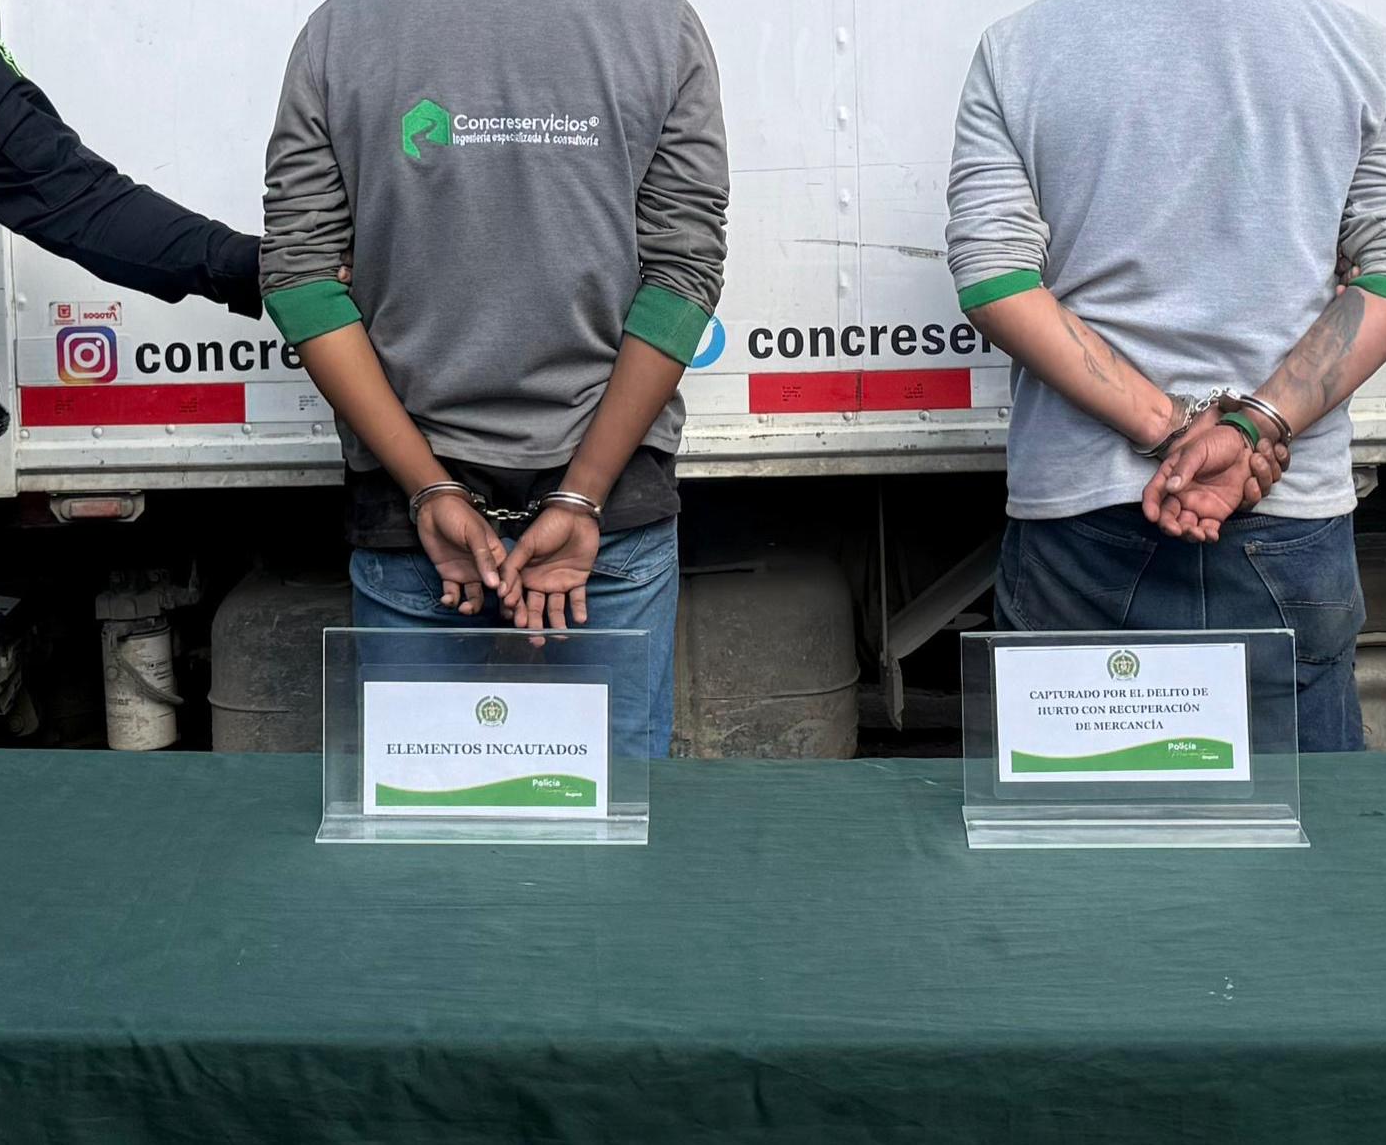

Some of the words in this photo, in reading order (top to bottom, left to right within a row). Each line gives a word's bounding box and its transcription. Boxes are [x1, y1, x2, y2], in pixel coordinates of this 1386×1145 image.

[1029, 690, 1101, 700] CAPTURADO
[1103, 688, 1127, 699] POR
[1129, 688, 1145, 698] EL
[1147, 687, 1190, 697] DELITO
[1192, 687, 1209, 697] DE
[1038, 705, 1079, 715] HURTO
[1081, 705, 1106, 715] CON
[1109, 702, 1201, 714] RECUPERACIÓN
[1076, 722, 1091, 731] DE
[1093, 719, 1164, 731] MERCANCÍA
[386, 743, 482, 755] ELEMENTOS
[486, 743, 588, 756] INCAUTADOS
